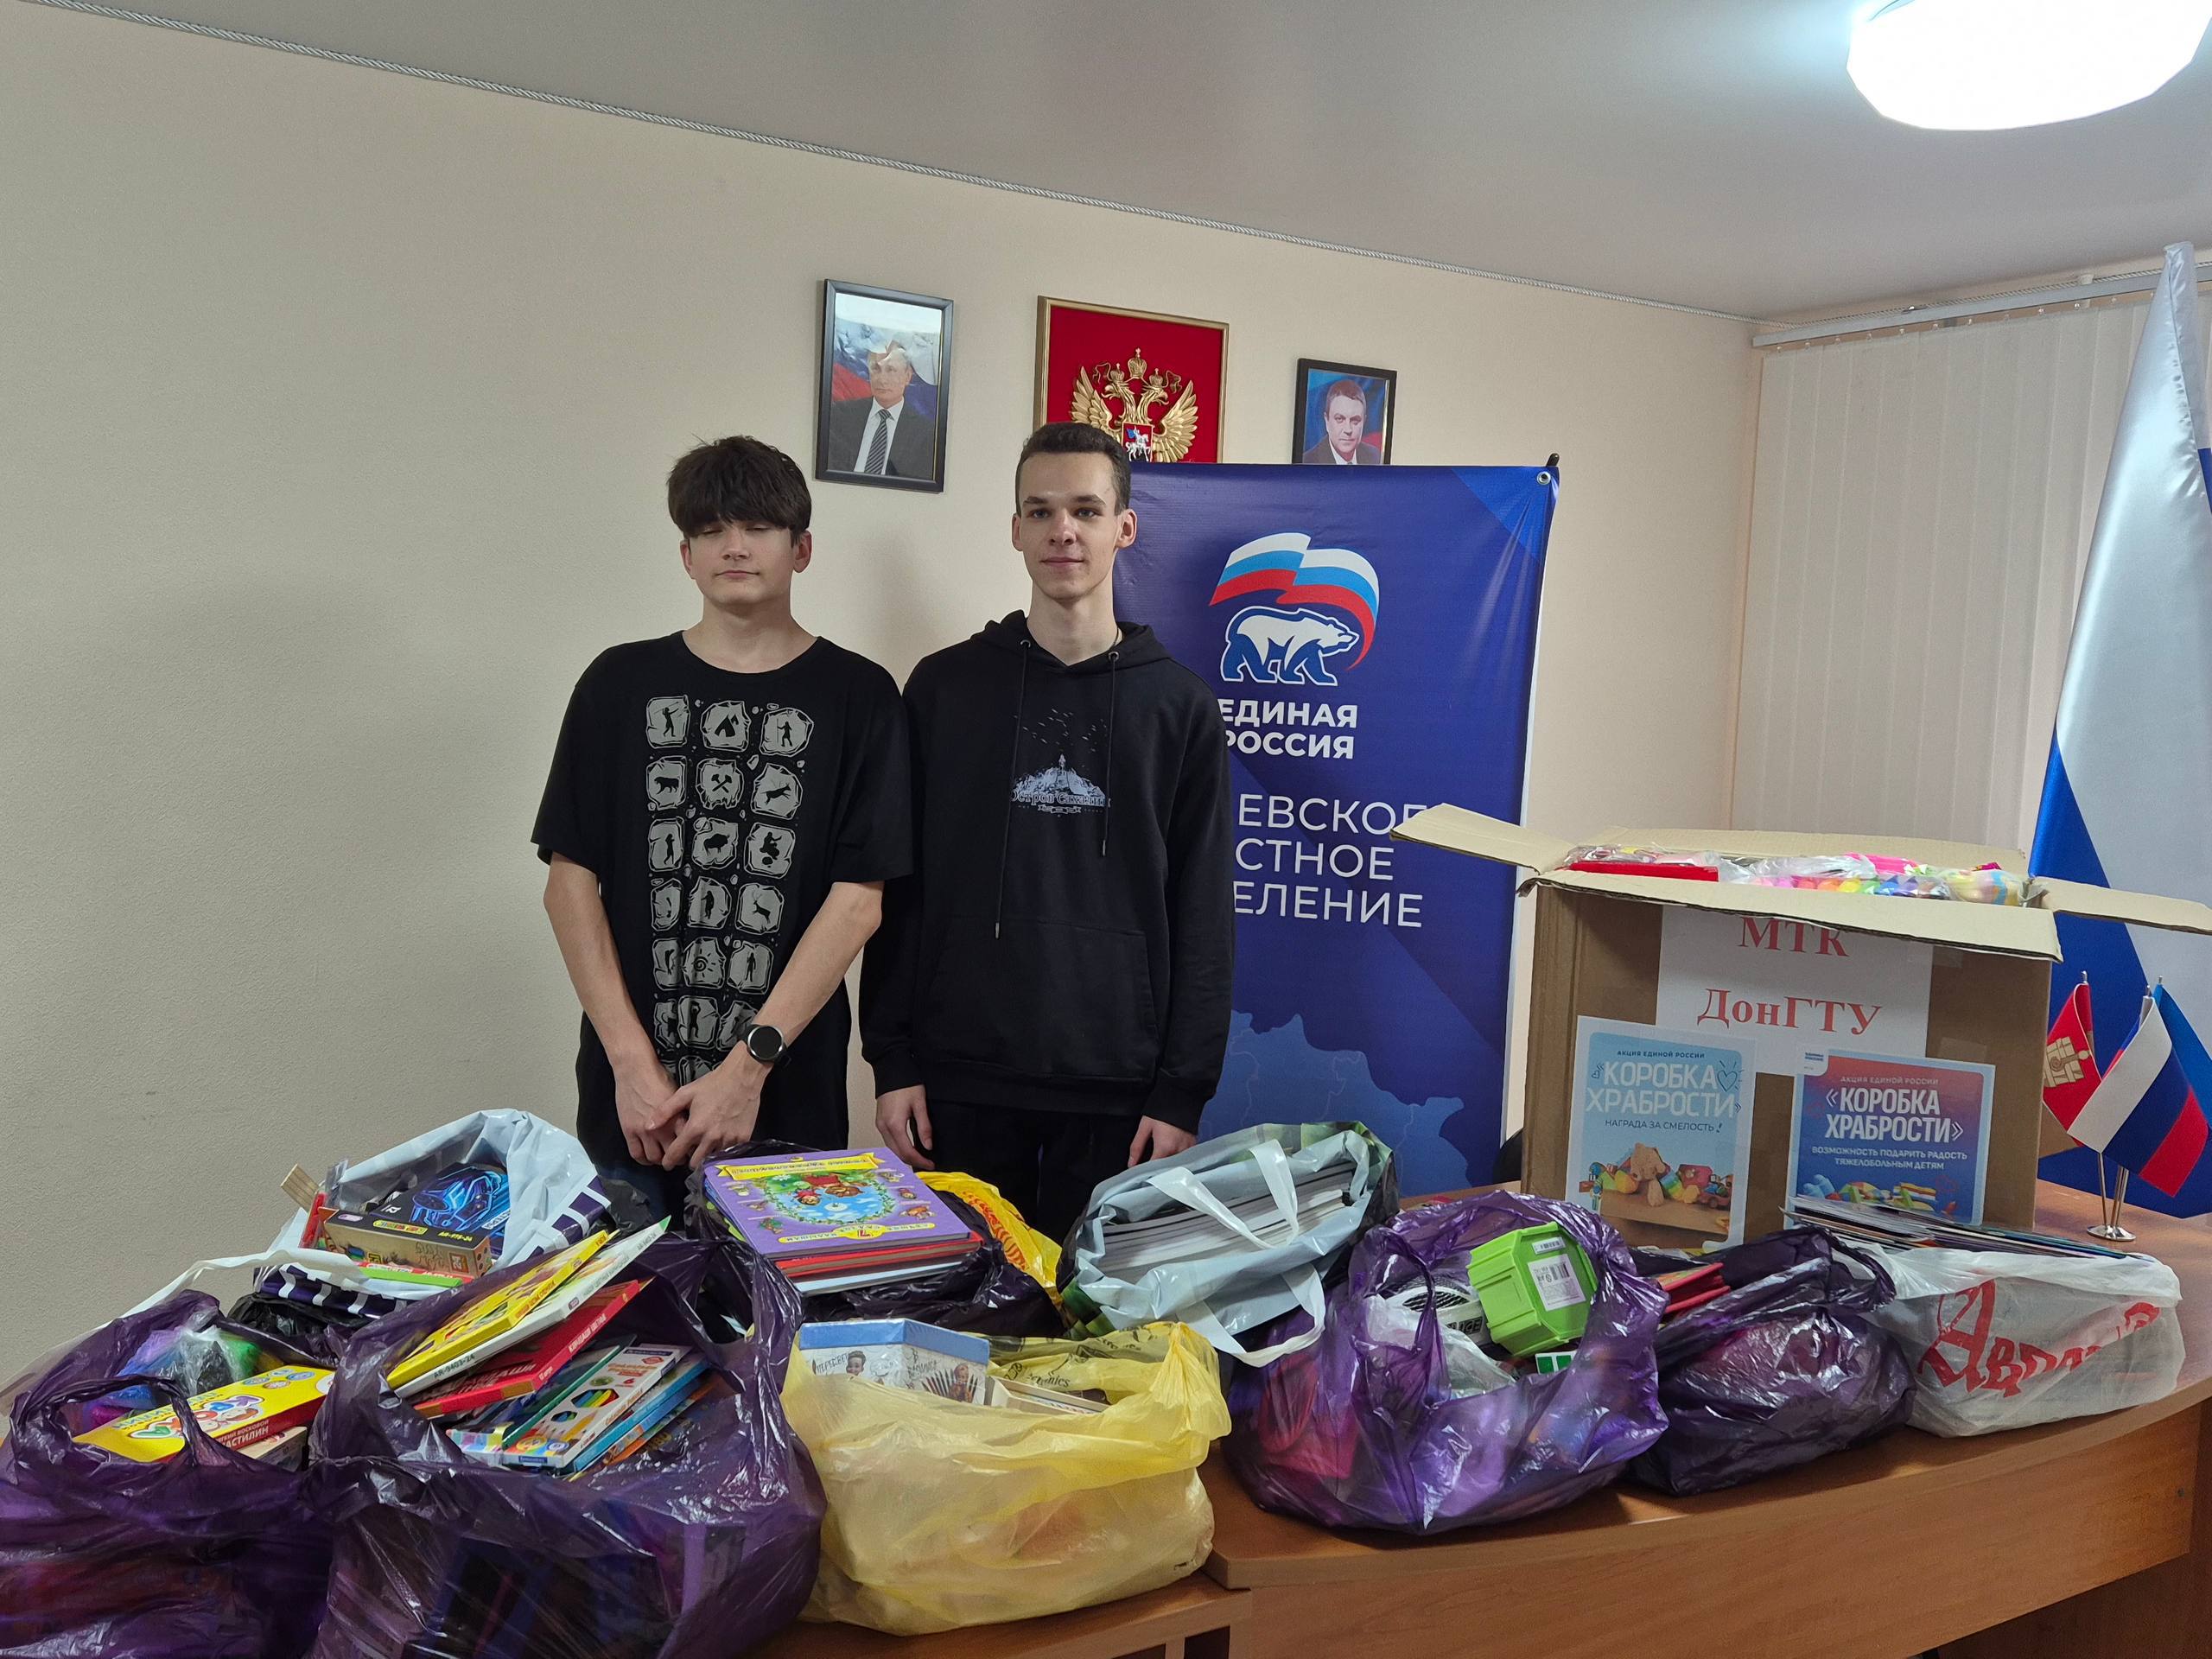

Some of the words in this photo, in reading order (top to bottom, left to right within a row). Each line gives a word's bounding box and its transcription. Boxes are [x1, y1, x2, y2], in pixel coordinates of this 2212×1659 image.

[1217, 699, 1357, 728] ЕДИНАЯ
[1235, 837, 1395, 880] СТНОЕ
[1233, 880, 1423, 928] ЕЛЕНИЕ
[1738, 917, 1849, 957] МТК
[1697, 988, 1883, 1035] ДонГТУ
[1870, 1076, 1904, 1084] ЕДИНОЙ
[1826, 1087, 1941, 1116] «КОРОБКА
[1605, 1119, 1647, 1128] НАГРАДА
[1825, 1113, 1964, 1143] ХРАБРОСТИ»
[1812, 1147, 1878, 1156] ВОЗМОЖНОСТЬ
[1879, 1148, 1926, 1159] ПОДАРИТЬ
[1928, 1151, 1967, 1160] РАДОСТЬ
[1834, 1158, 1913, 1169] ТЯЖЕЛОБОЛЬНЫМ
[1914, 1160, 1944, 1170] ДЕТЯМ
